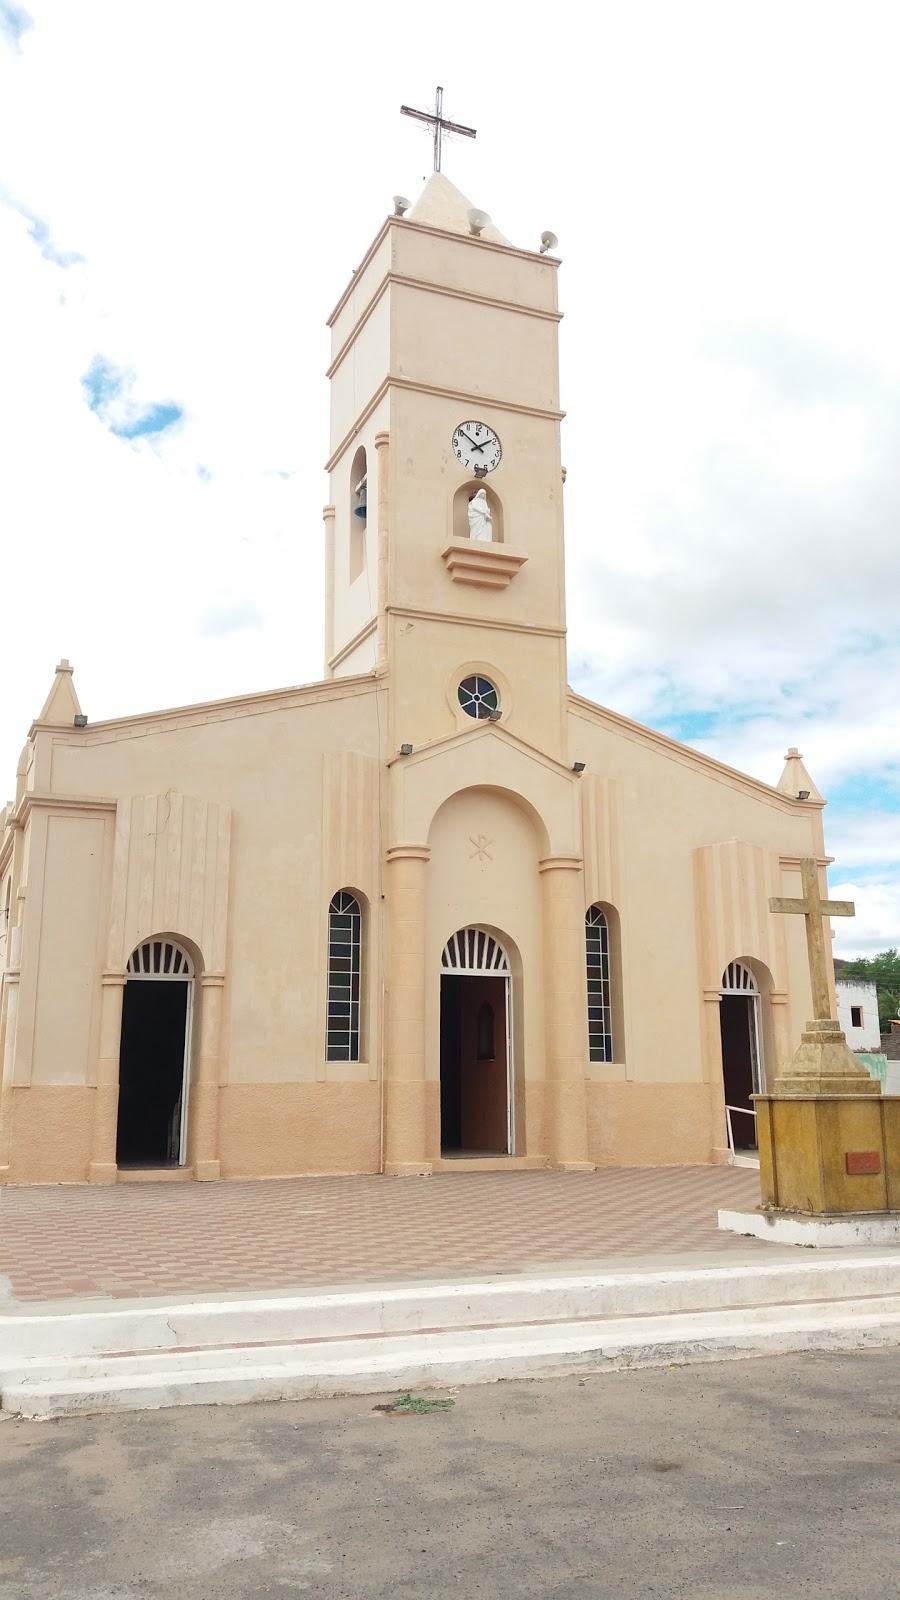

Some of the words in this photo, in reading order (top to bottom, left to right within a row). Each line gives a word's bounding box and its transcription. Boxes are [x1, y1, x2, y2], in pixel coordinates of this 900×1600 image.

[476, 424, 482, 432] 12
[457, 450, 461, 458] 8
[465, 459, 469, 467] 7
